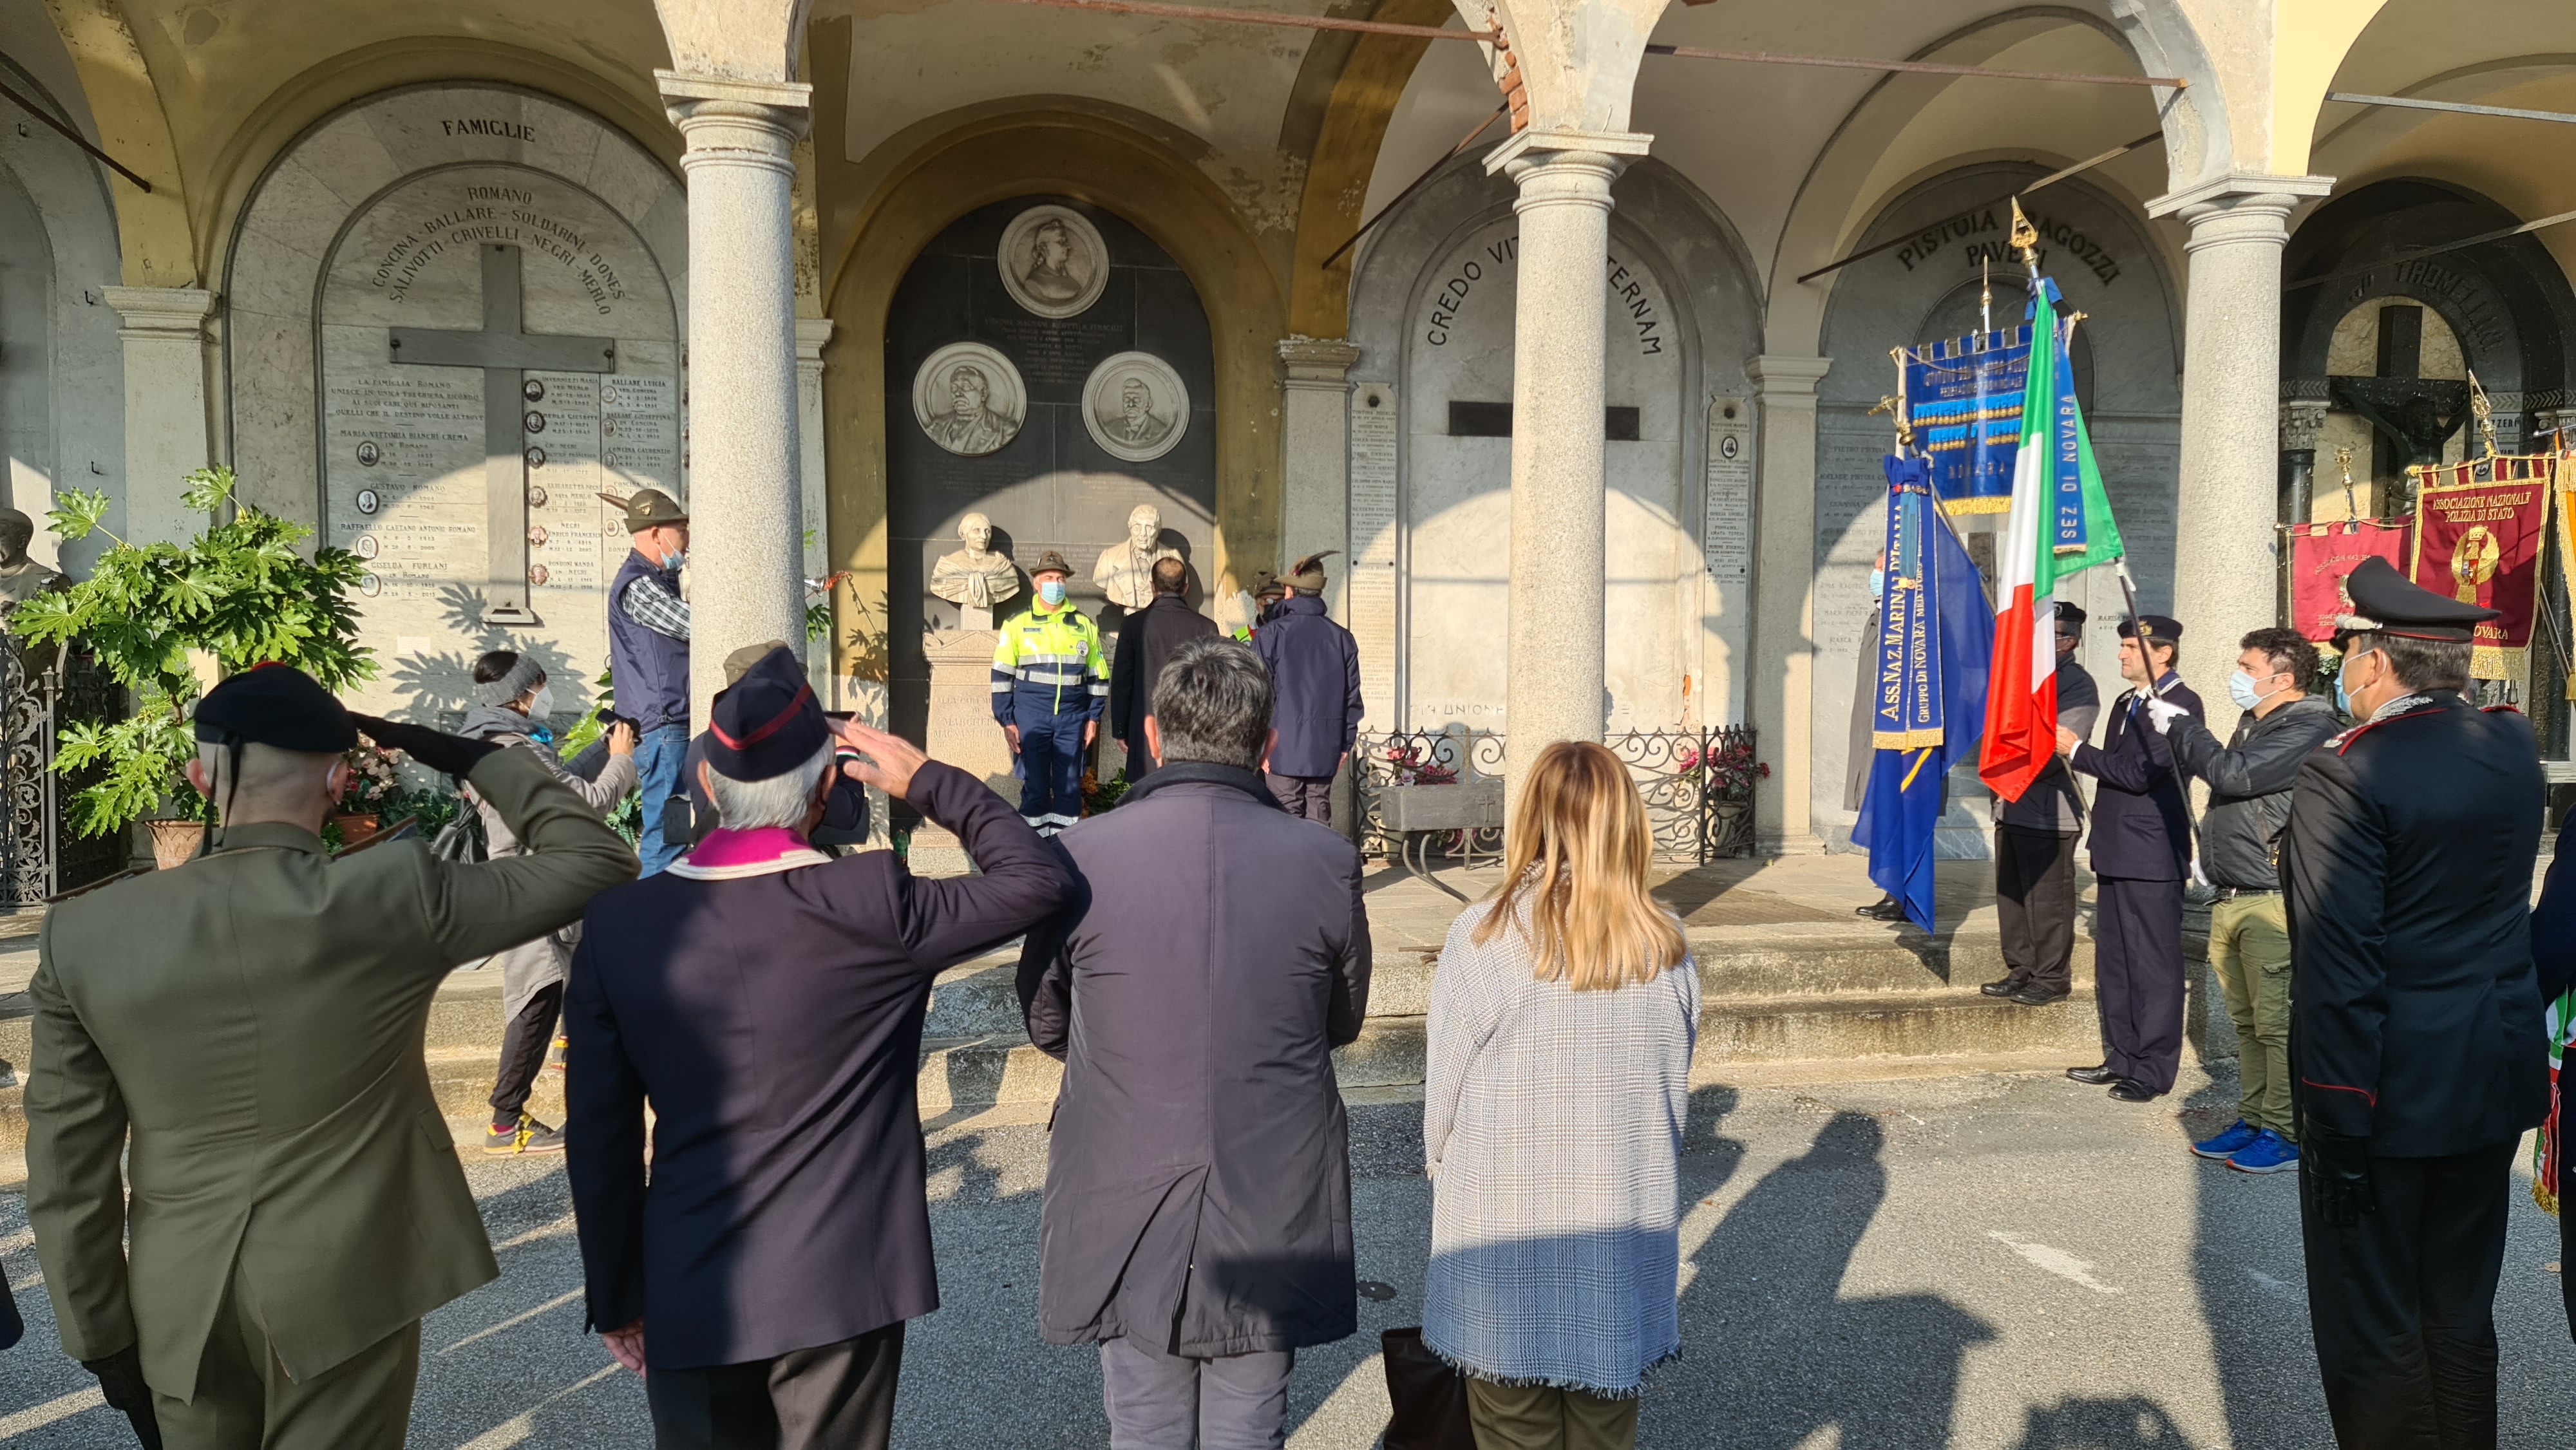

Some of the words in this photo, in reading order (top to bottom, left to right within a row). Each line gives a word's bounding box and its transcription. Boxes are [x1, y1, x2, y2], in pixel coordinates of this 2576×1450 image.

[440, 118, 535, 143] FAMIGLIE
[468, 187, 533, 205] ROMANO
[372, 235, 419, 288] CONCINA
[424, 207, 497, 234] BALLARE
[511, 210, 585, 252] SOLDARINI
[589, 253, 625, 300] DONES
[1897, 210, 1999, 272] PISTOIA
[1965, 242, 2047, 270] PAVEI
[390, 240, 444, 304] SALIVOTTI
[451, 225, 519, 244] CRIVELLI
[531, 234, 576, 266] NEGRI
[578, 269, 611, 315] MERLO
[1427, 261, 1482, 346] CREDO
[1606, 255, 1662, 355] TERNAM
[2060, 395, 2078, 463] NOVARA
[2061, 475, 2078, 493] DI
[2433, 496, 2485, 510] ASSOCIAZIONE
[2486, 492, 2532, 507] NAZIONALE
[341, 523, 382, 532] RAFFAELLO
[2445, 510, 2476, 523] POLIZIA
[2476, 509, 2486, 522] DI
[2488, 507, 2515, 521] STATO
[1913, 620, 1927, 670] NOVARA
[2473, 625, 2508, 640] OVARA
[1916, 671, 1927, 684] DI
[1917, 684, 1930, 723] GRUPPO
